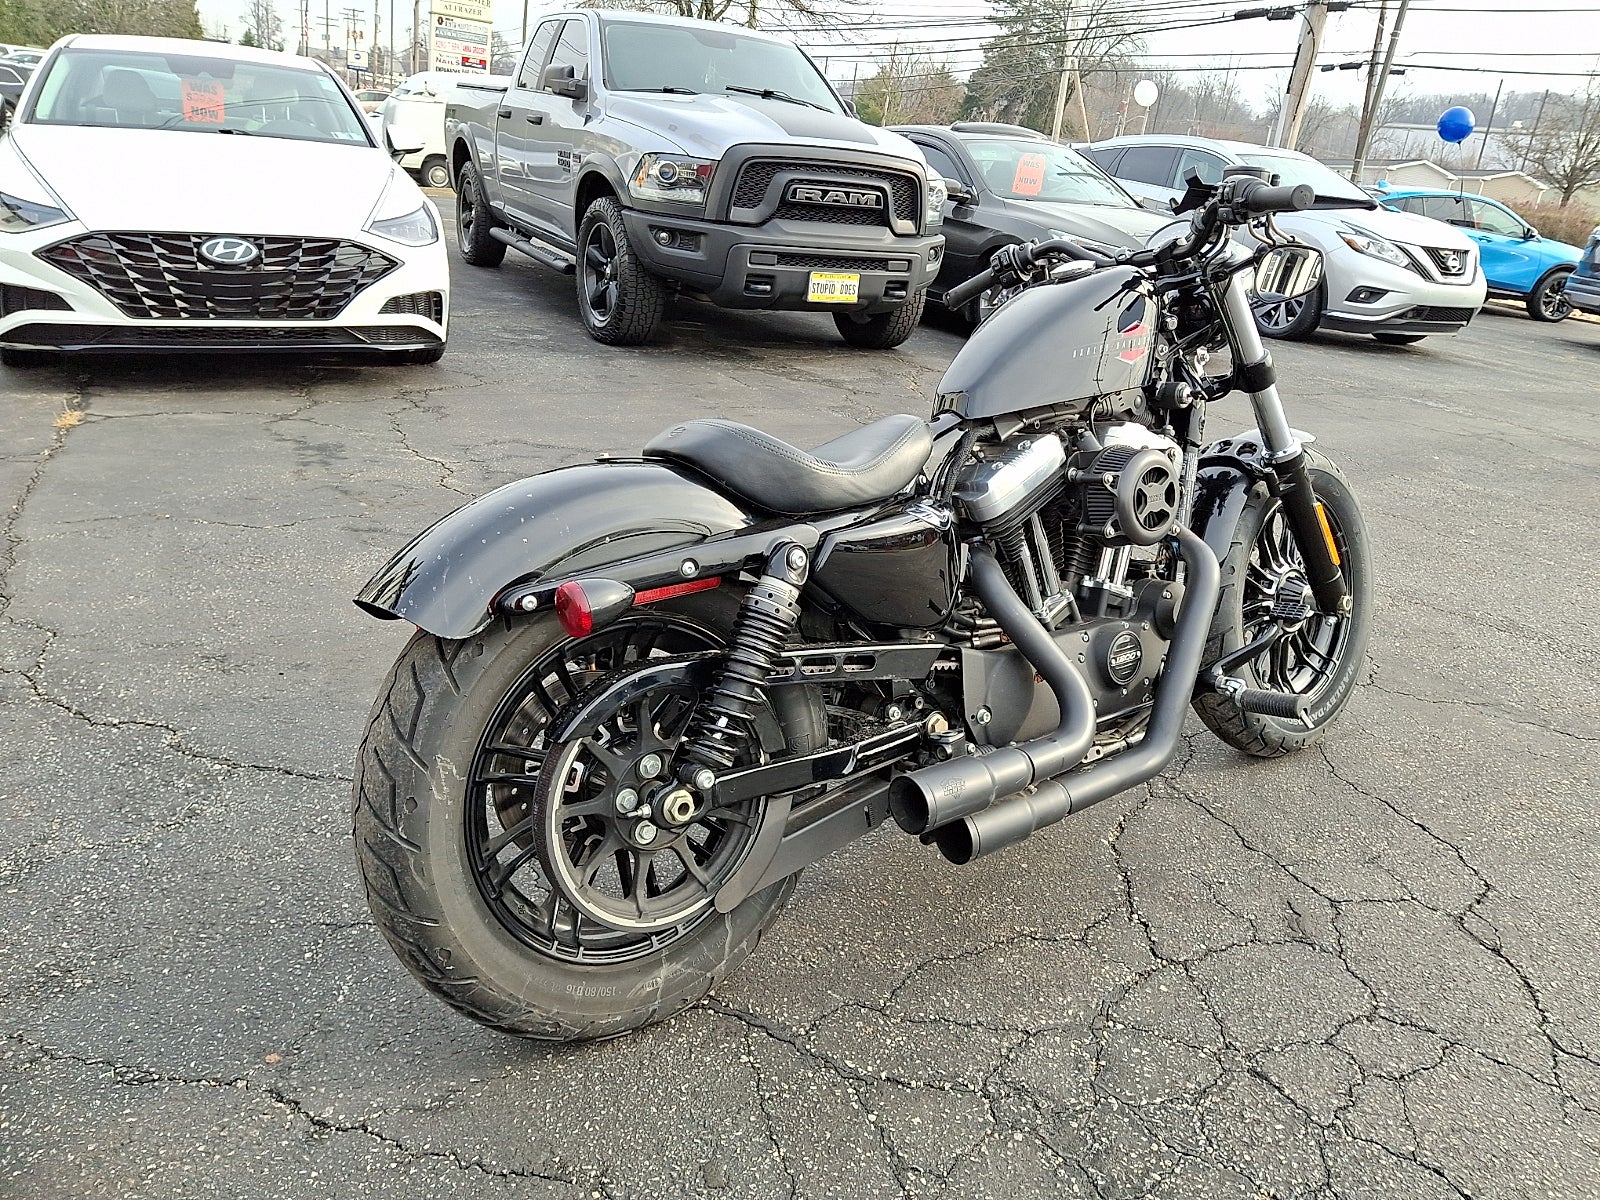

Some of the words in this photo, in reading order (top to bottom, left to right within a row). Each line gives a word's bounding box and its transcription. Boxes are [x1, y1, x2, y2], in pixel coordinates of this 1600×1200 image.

[454, 5, 482, 16] FRAZER
[435, 56, 460, 66] NAILS
[1023, 160, 1040, 168] WAS
[1019, 176, 1038, 185] NOW
[796, 188, 877, 206] RAM
[811, 282, 836, 294] STUPID
[839, 283, 857, 295] DOES
[585, 985, 617, 997] 150/80
